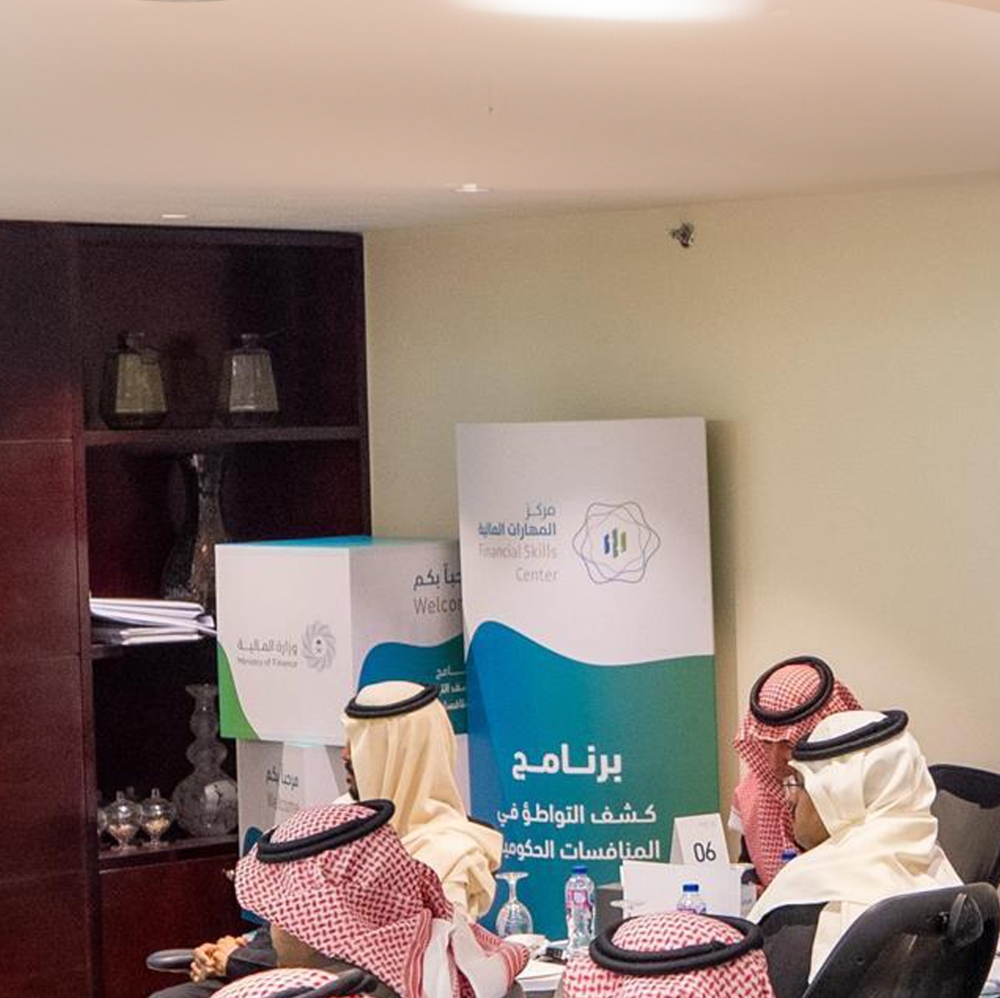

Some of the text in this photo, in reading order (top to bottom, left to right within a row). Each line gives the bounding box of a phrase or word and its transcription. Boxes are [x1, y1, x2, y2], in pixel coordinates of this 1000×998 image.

[525, 502, 556, 520] مركز
[507, 521, 556, 541] المهارات
[523, 542, 558, 560] Skills
[413, 569, 440, 590] بكم
[515, 566, 558, 583] Center
[413, 596, 462, 615] Welco
[276, 638, 298, 656] وزارة
[512, 743, 622, 783] برنامج
[496, 802, 657, 828] كشف التواطؤ في
[502, 839, 661, 862] المنافسات الحكومي
[693, 841, 717, 862] 06
